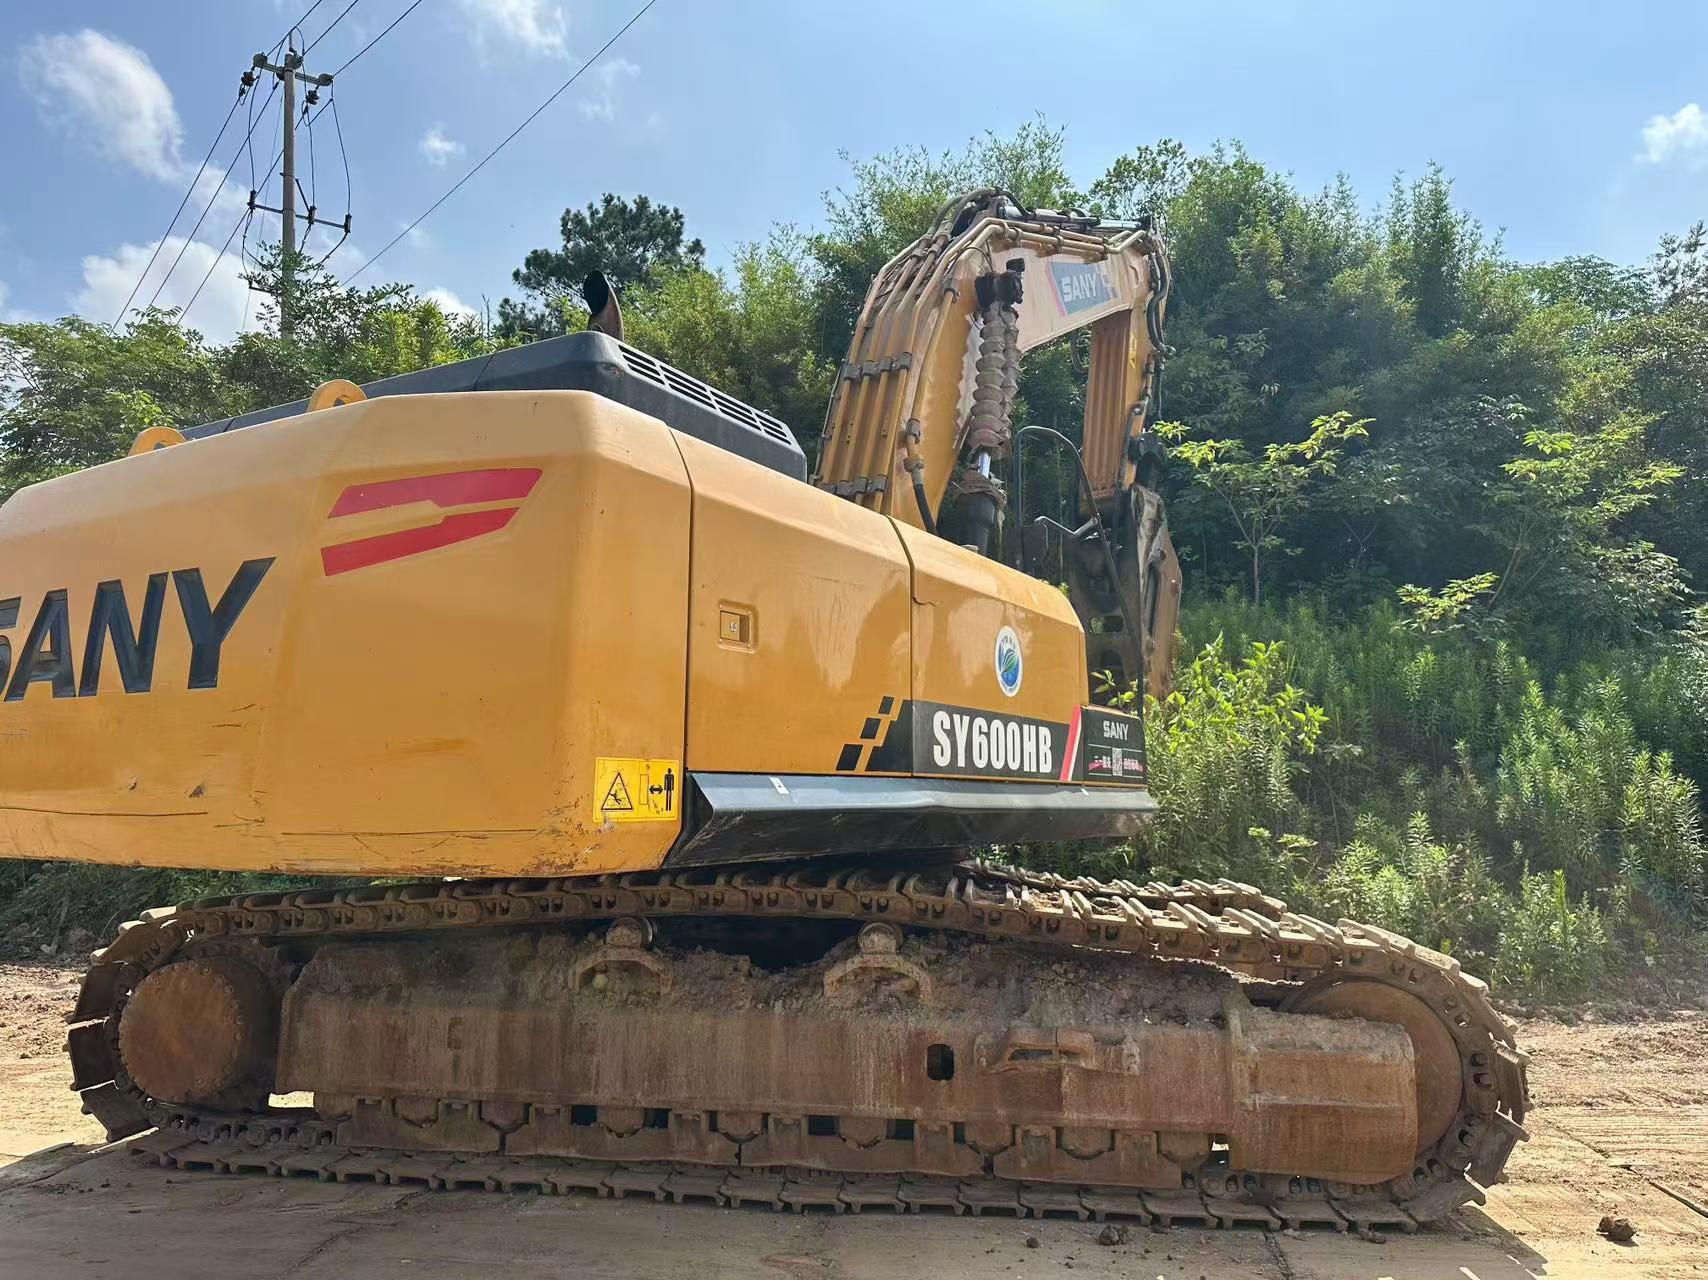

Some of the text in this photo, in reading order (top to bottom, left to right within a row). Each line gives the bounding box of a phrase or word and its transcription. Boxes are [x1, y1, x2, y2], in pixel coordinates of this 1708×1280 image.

[1062, 272, 1097, 302] SANY
[933, 711, 1052, 773] SY600HB
[1103, 720, 1129, 740] SANY
